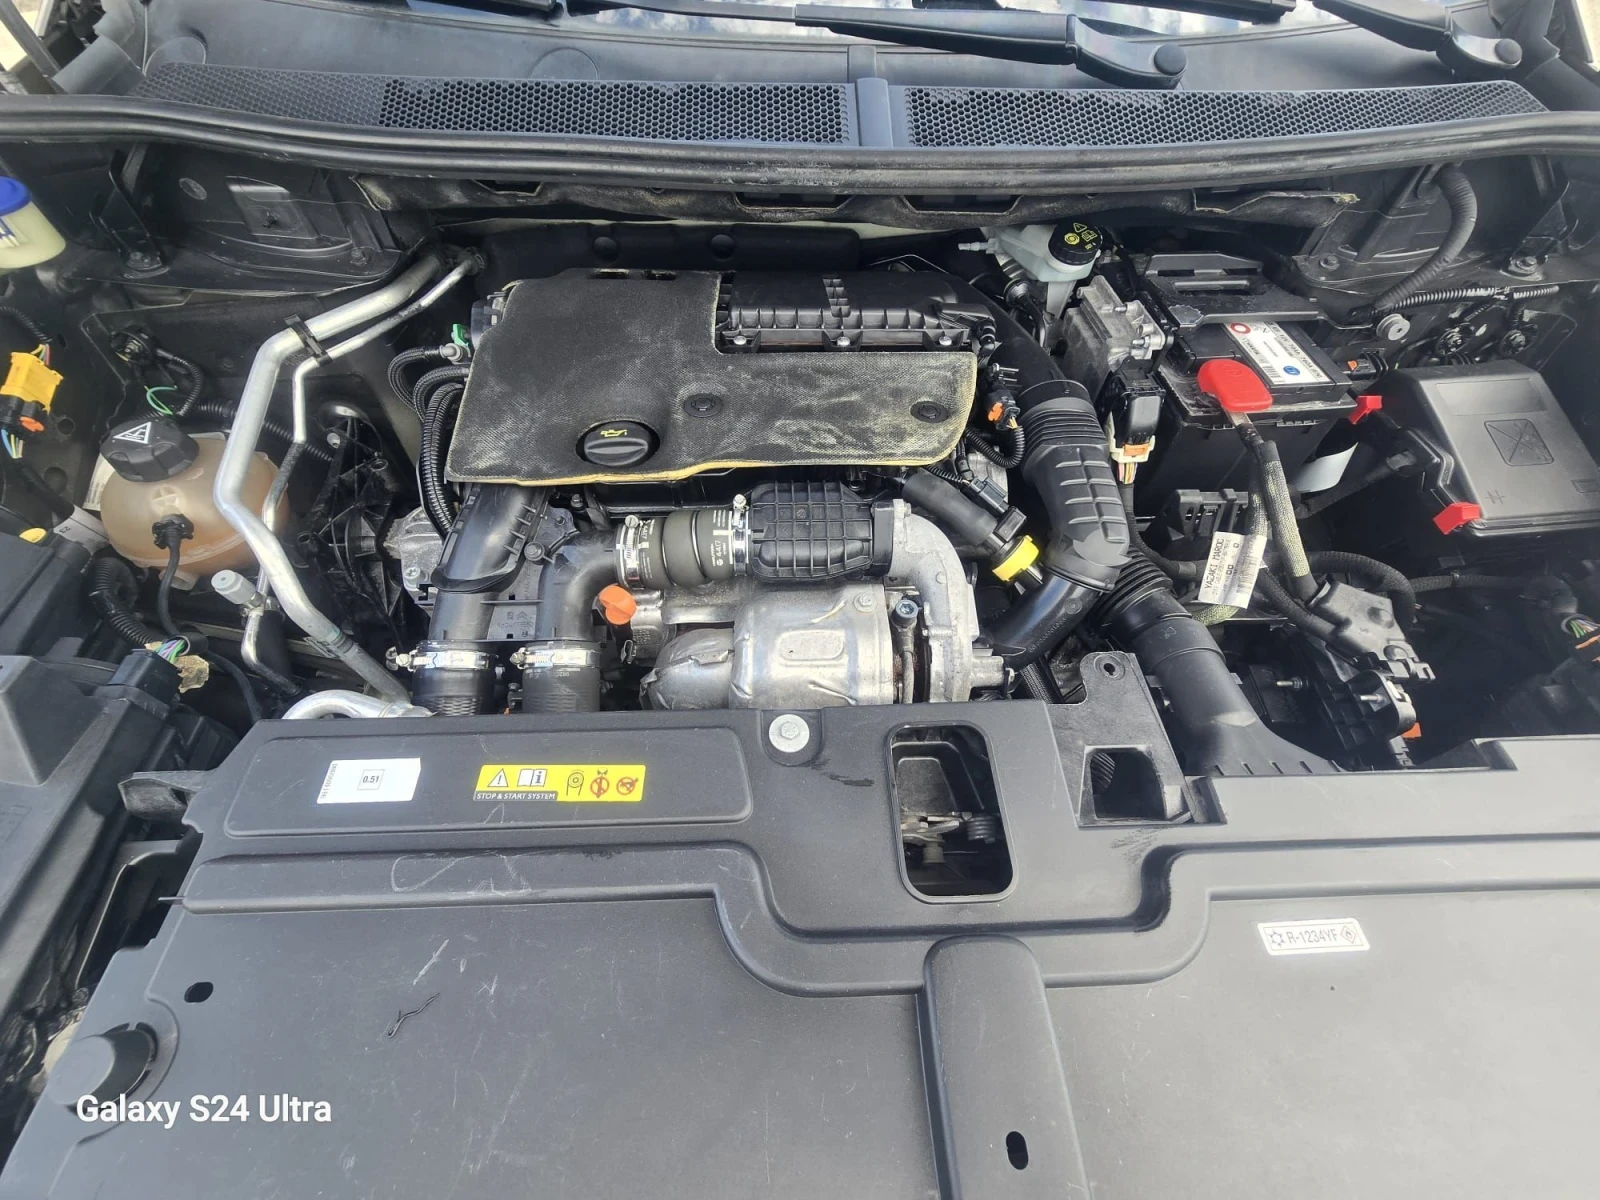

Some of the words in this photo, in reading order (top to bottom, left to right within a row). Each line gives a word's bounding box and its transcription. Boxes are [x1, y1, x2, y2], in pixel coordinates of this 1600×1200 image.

[1204, 564, 1219, 589] YAZAKI
[1212, 538, 1225, 560] MAROC
[362, 775, 380, 784] 0.51
[476, 792, 497, 800] STOP
[503, 792, 527, 800] START
[527, 792, 556, 800] SYSTEM
[1286, 928, 1338, 944] R-1234YF
